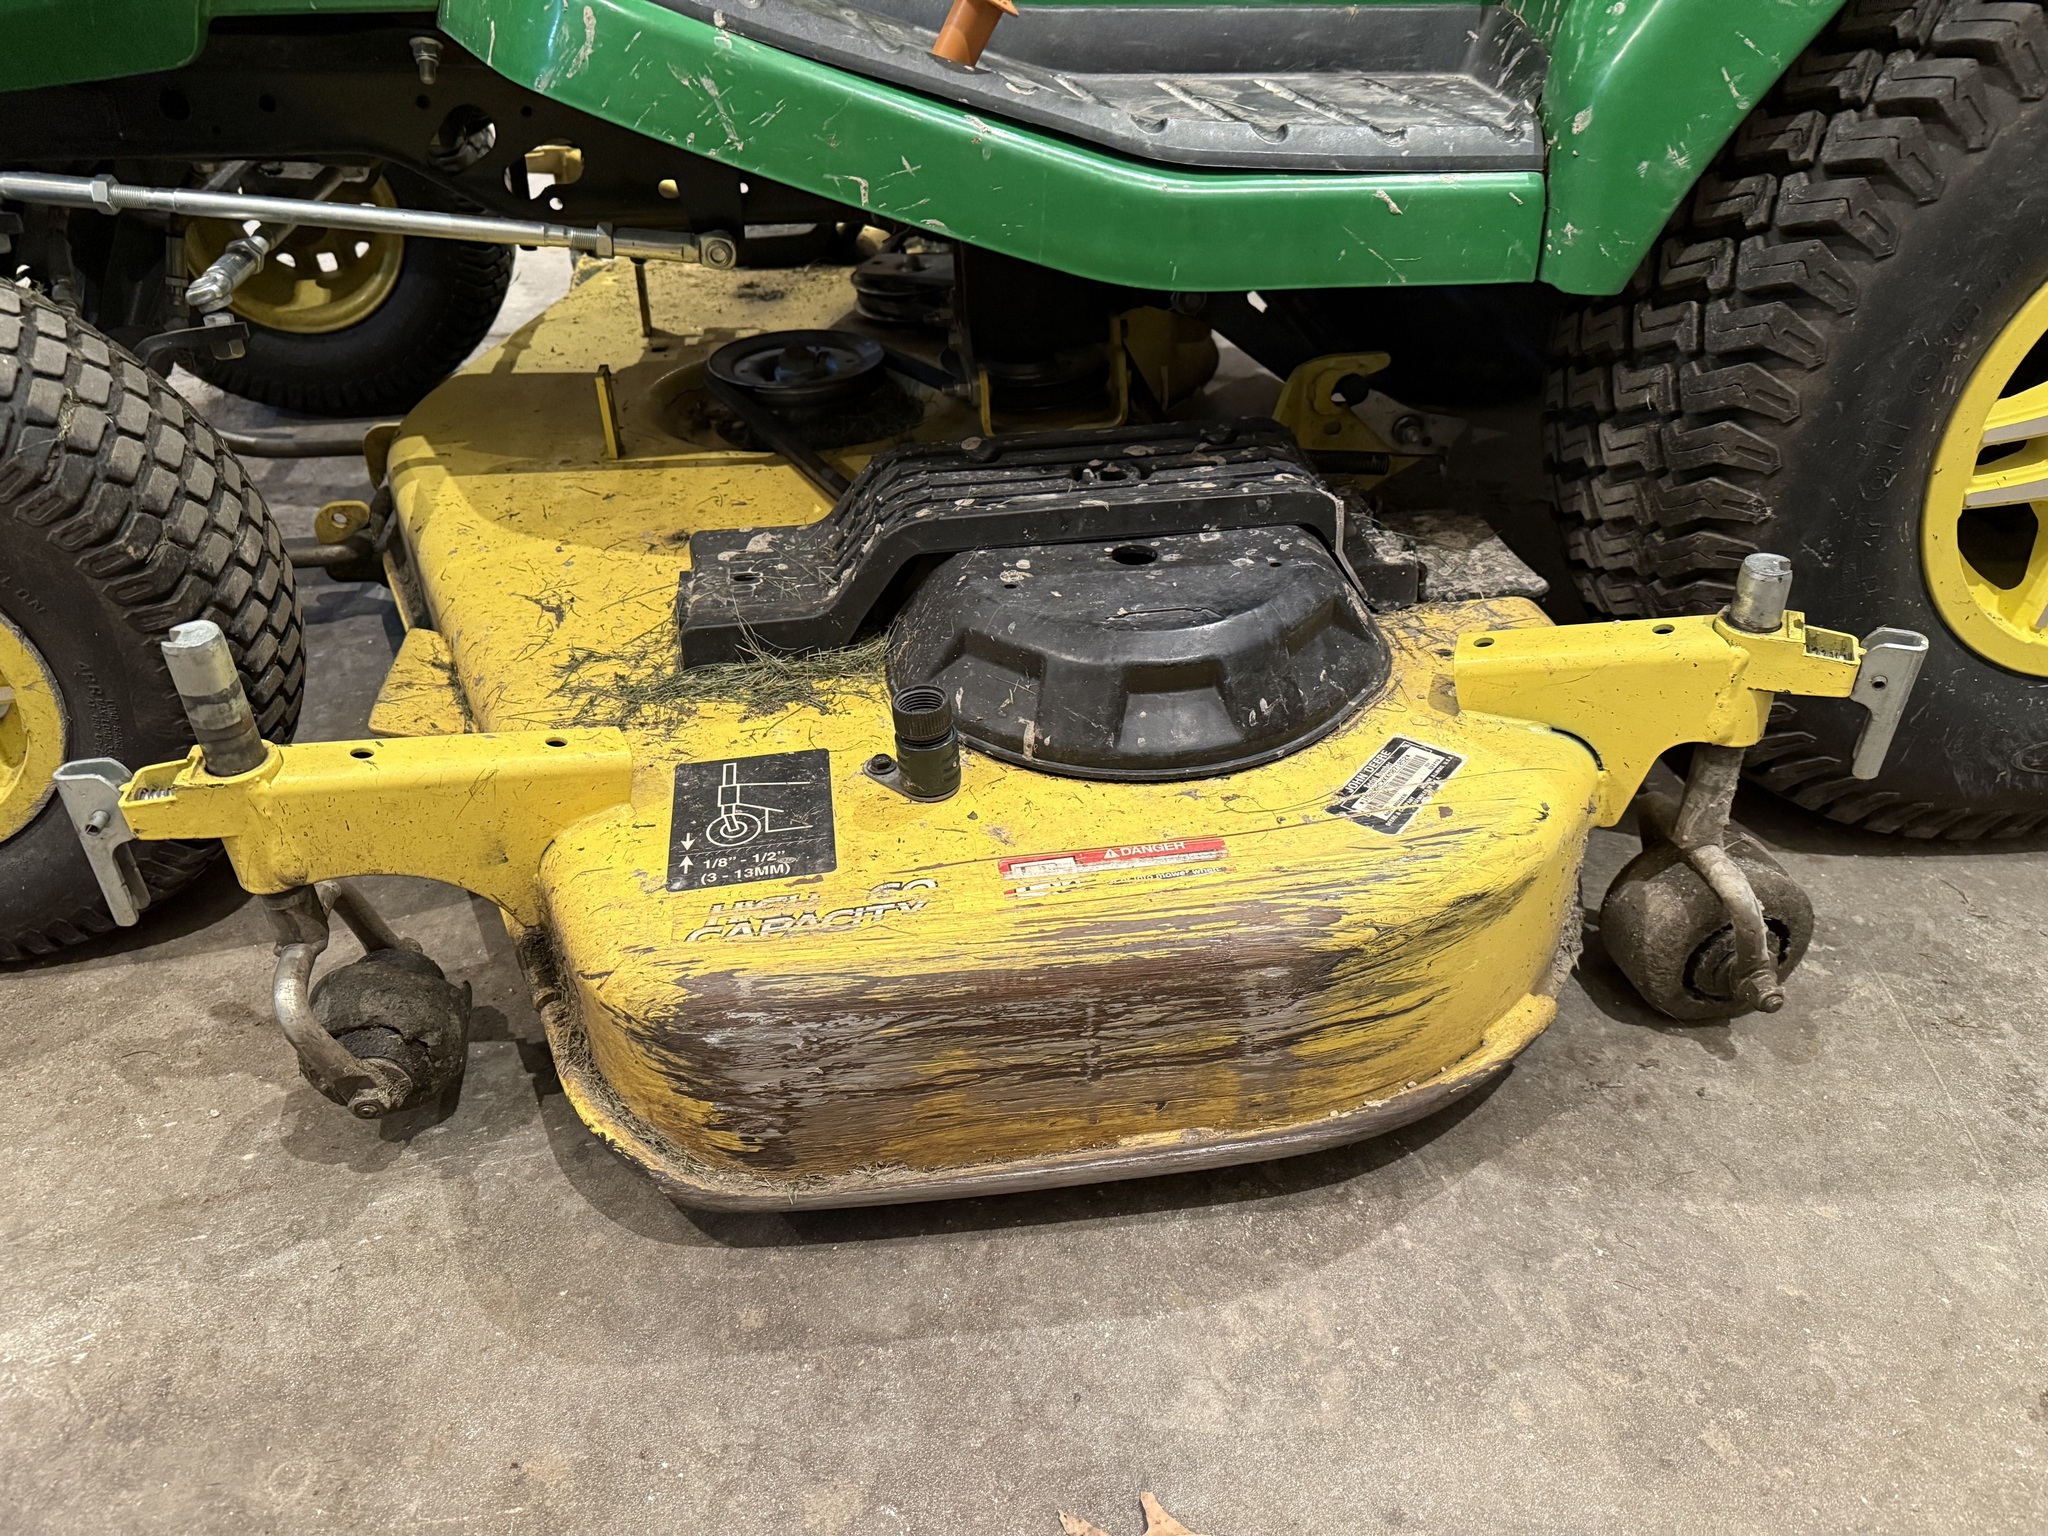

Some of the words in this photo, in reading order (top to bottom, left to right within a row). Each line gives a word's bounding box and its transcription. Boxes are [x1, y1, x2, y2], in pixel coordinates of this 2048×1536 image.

[1344, 772, 1368, 793] JOHN
[1366, 749, 1391, 772] DEERE
[1119, 842, 1186, 857] DANGER
[733, 863, 791, 880] 13MM)
